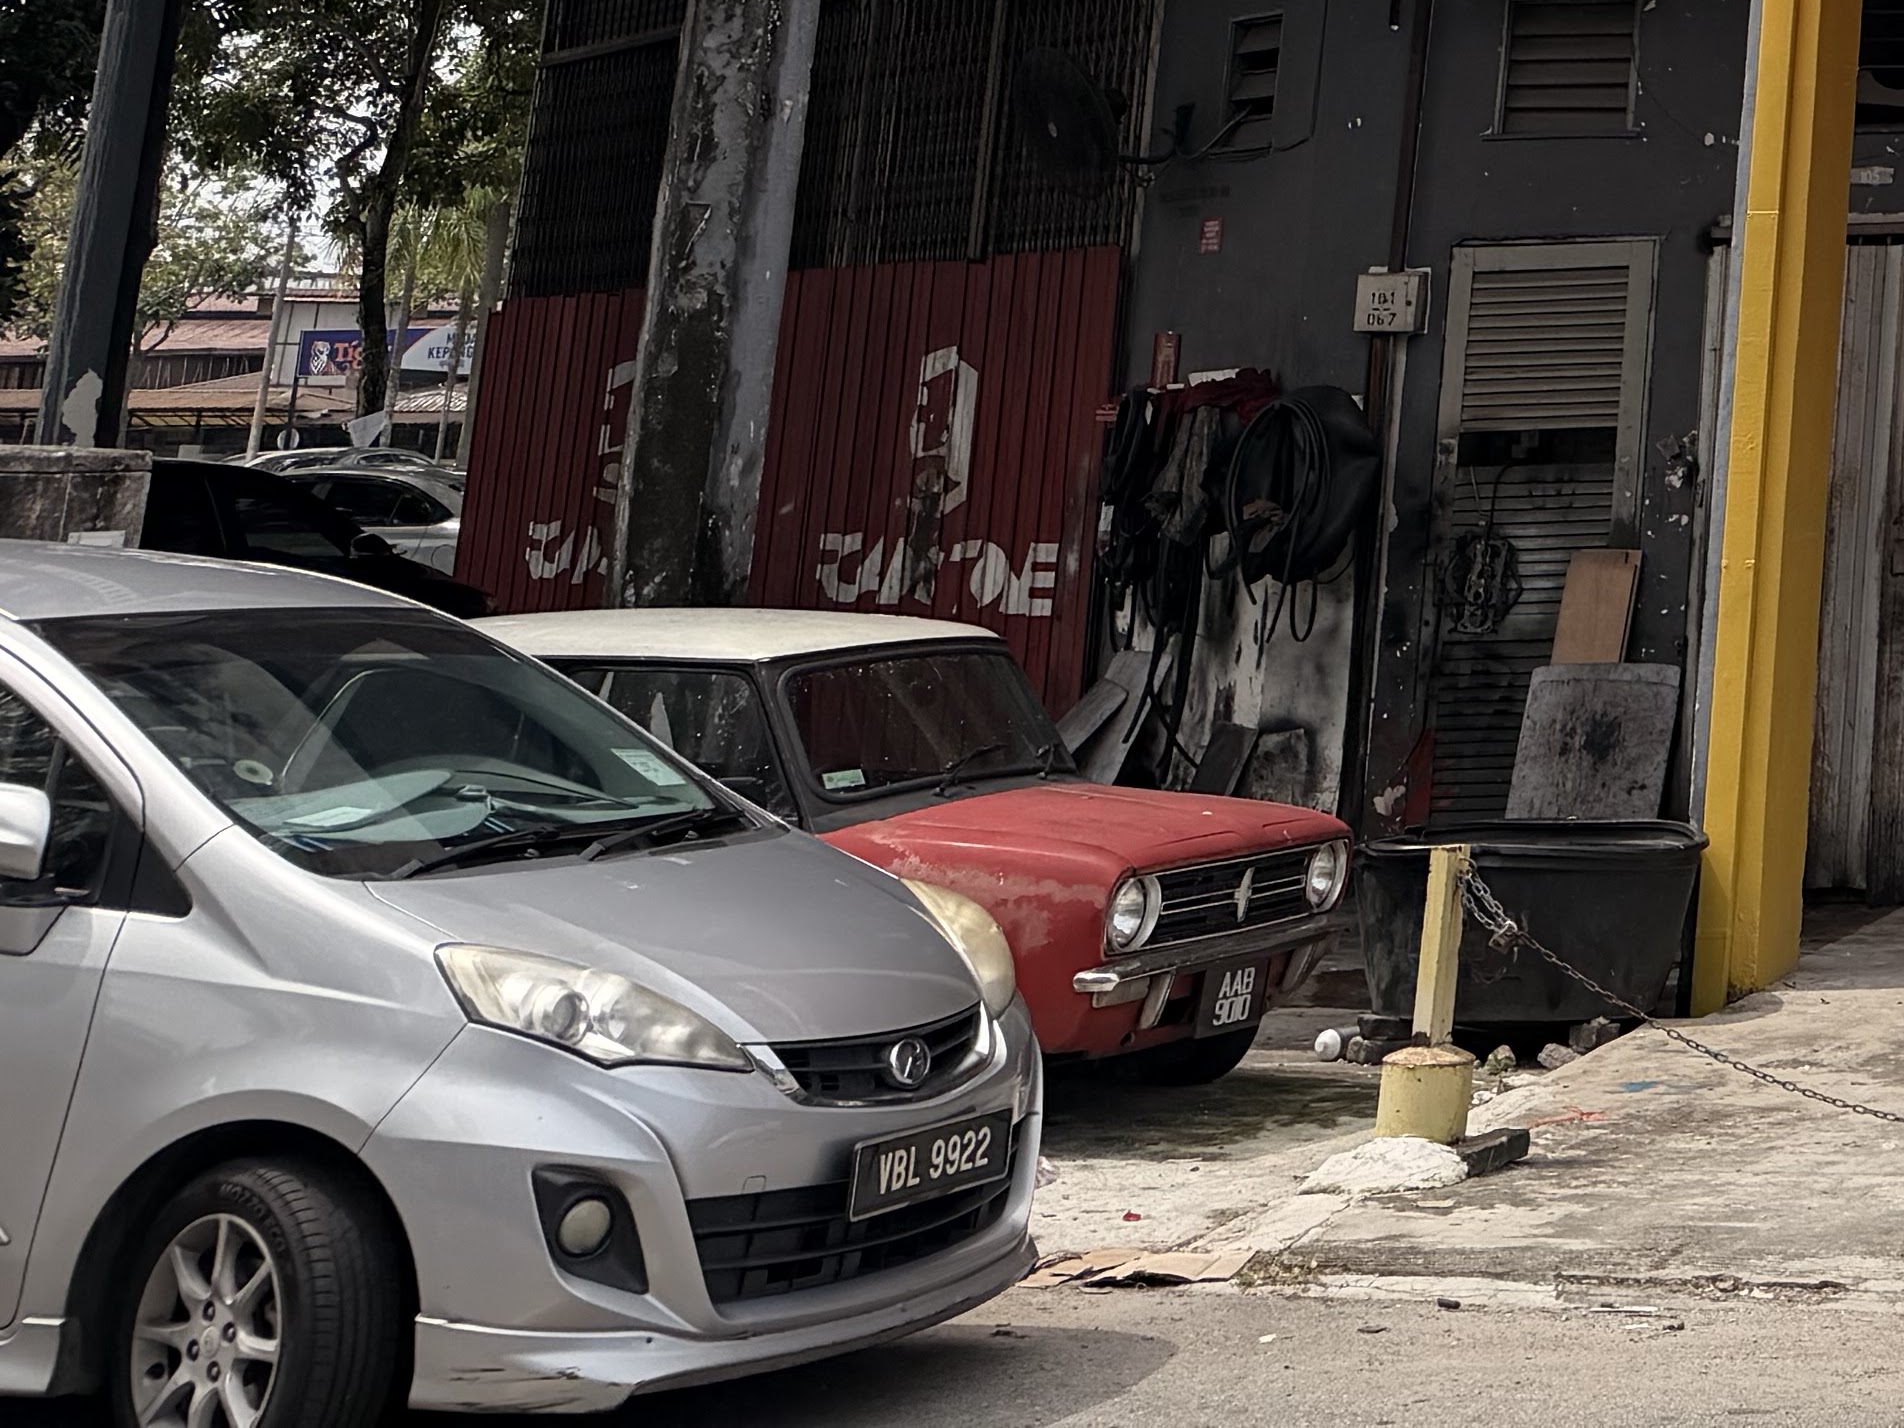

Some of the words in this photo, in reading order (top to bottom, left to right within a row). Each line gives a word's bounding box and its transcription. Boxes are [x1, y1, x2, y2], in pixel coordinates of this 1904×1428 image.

[1218, 967, 1256, 999] AAB
[1212, 994, 1252, 1027] 9010
[879, 1146, 921, 1194] VBL
[929, 1126, 992, 1180] 9922
